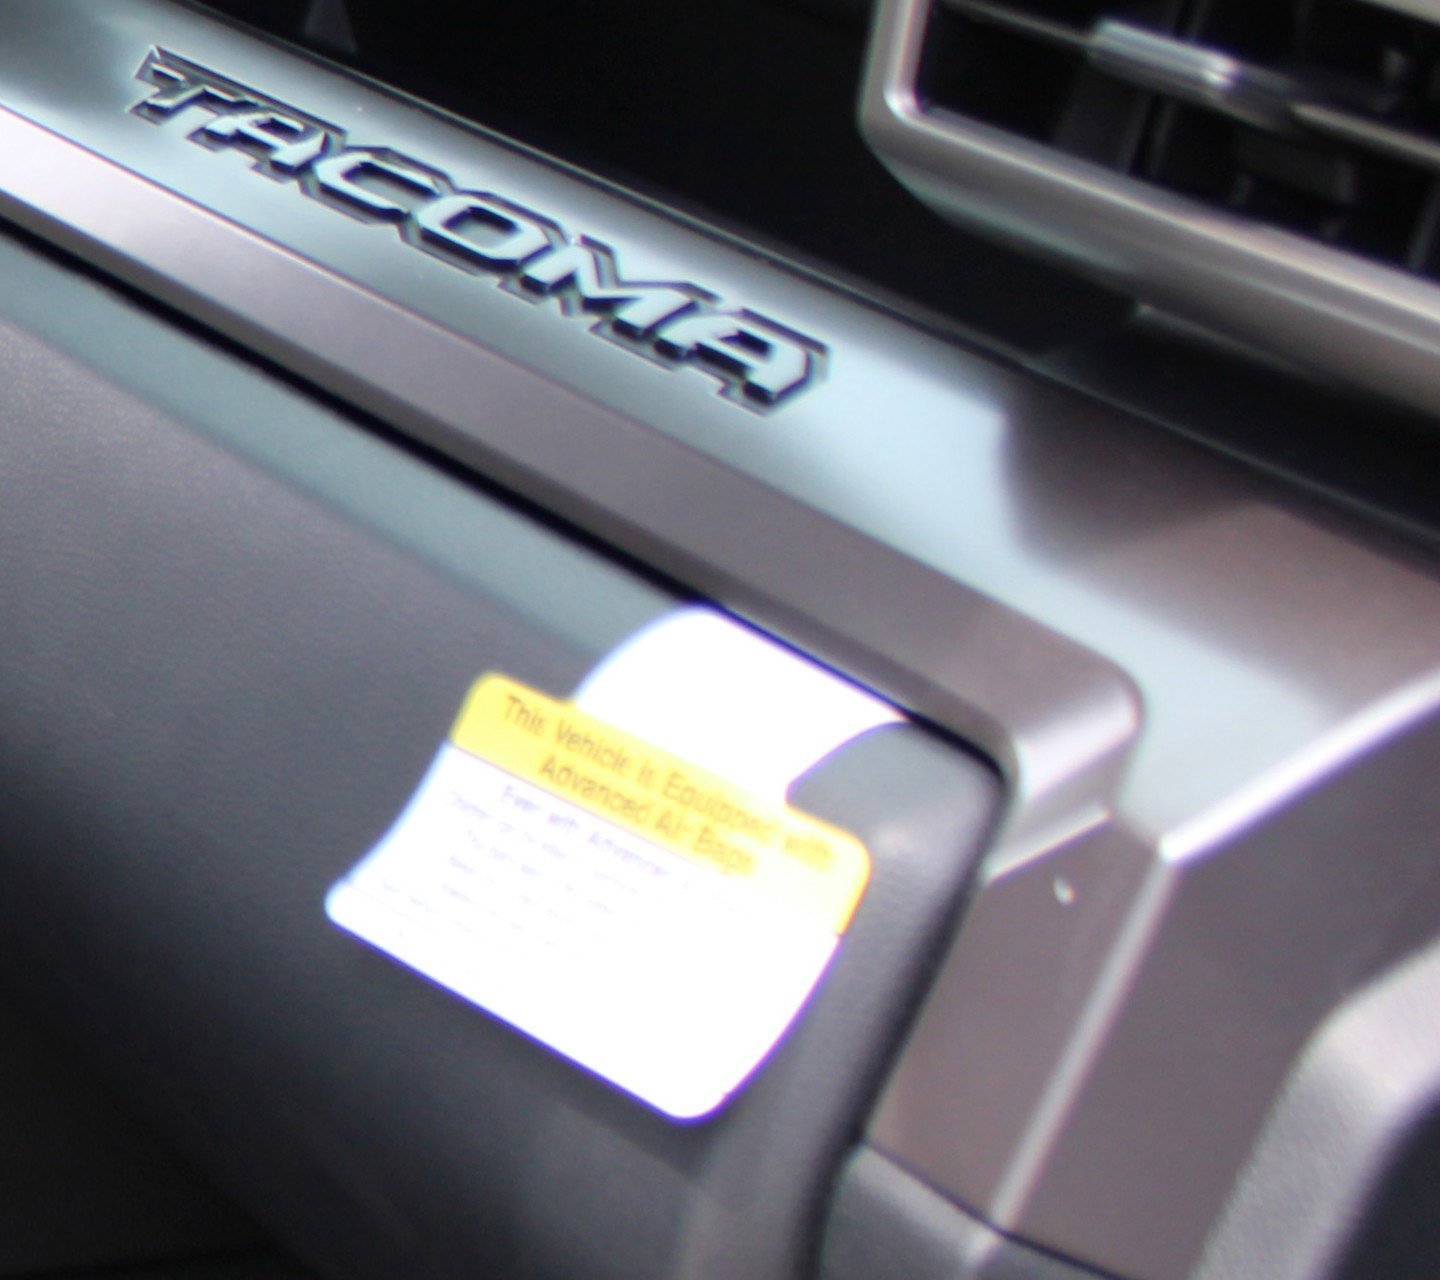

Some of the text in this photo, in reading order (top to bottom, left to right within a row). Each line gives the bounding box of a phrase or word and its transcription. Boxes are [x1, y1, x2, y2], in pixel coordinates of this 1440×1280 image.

[127, 45, 830, 417] TACOMA
[498, 694, 552, 739] This
[550, 719, 635, 777] Vehicle
[634, 758, 663, 790] is
[659, 770, 778, 848] Equipped
[536, 752, 654, 825] Advanced
[651, 806, 694, 844] Air
